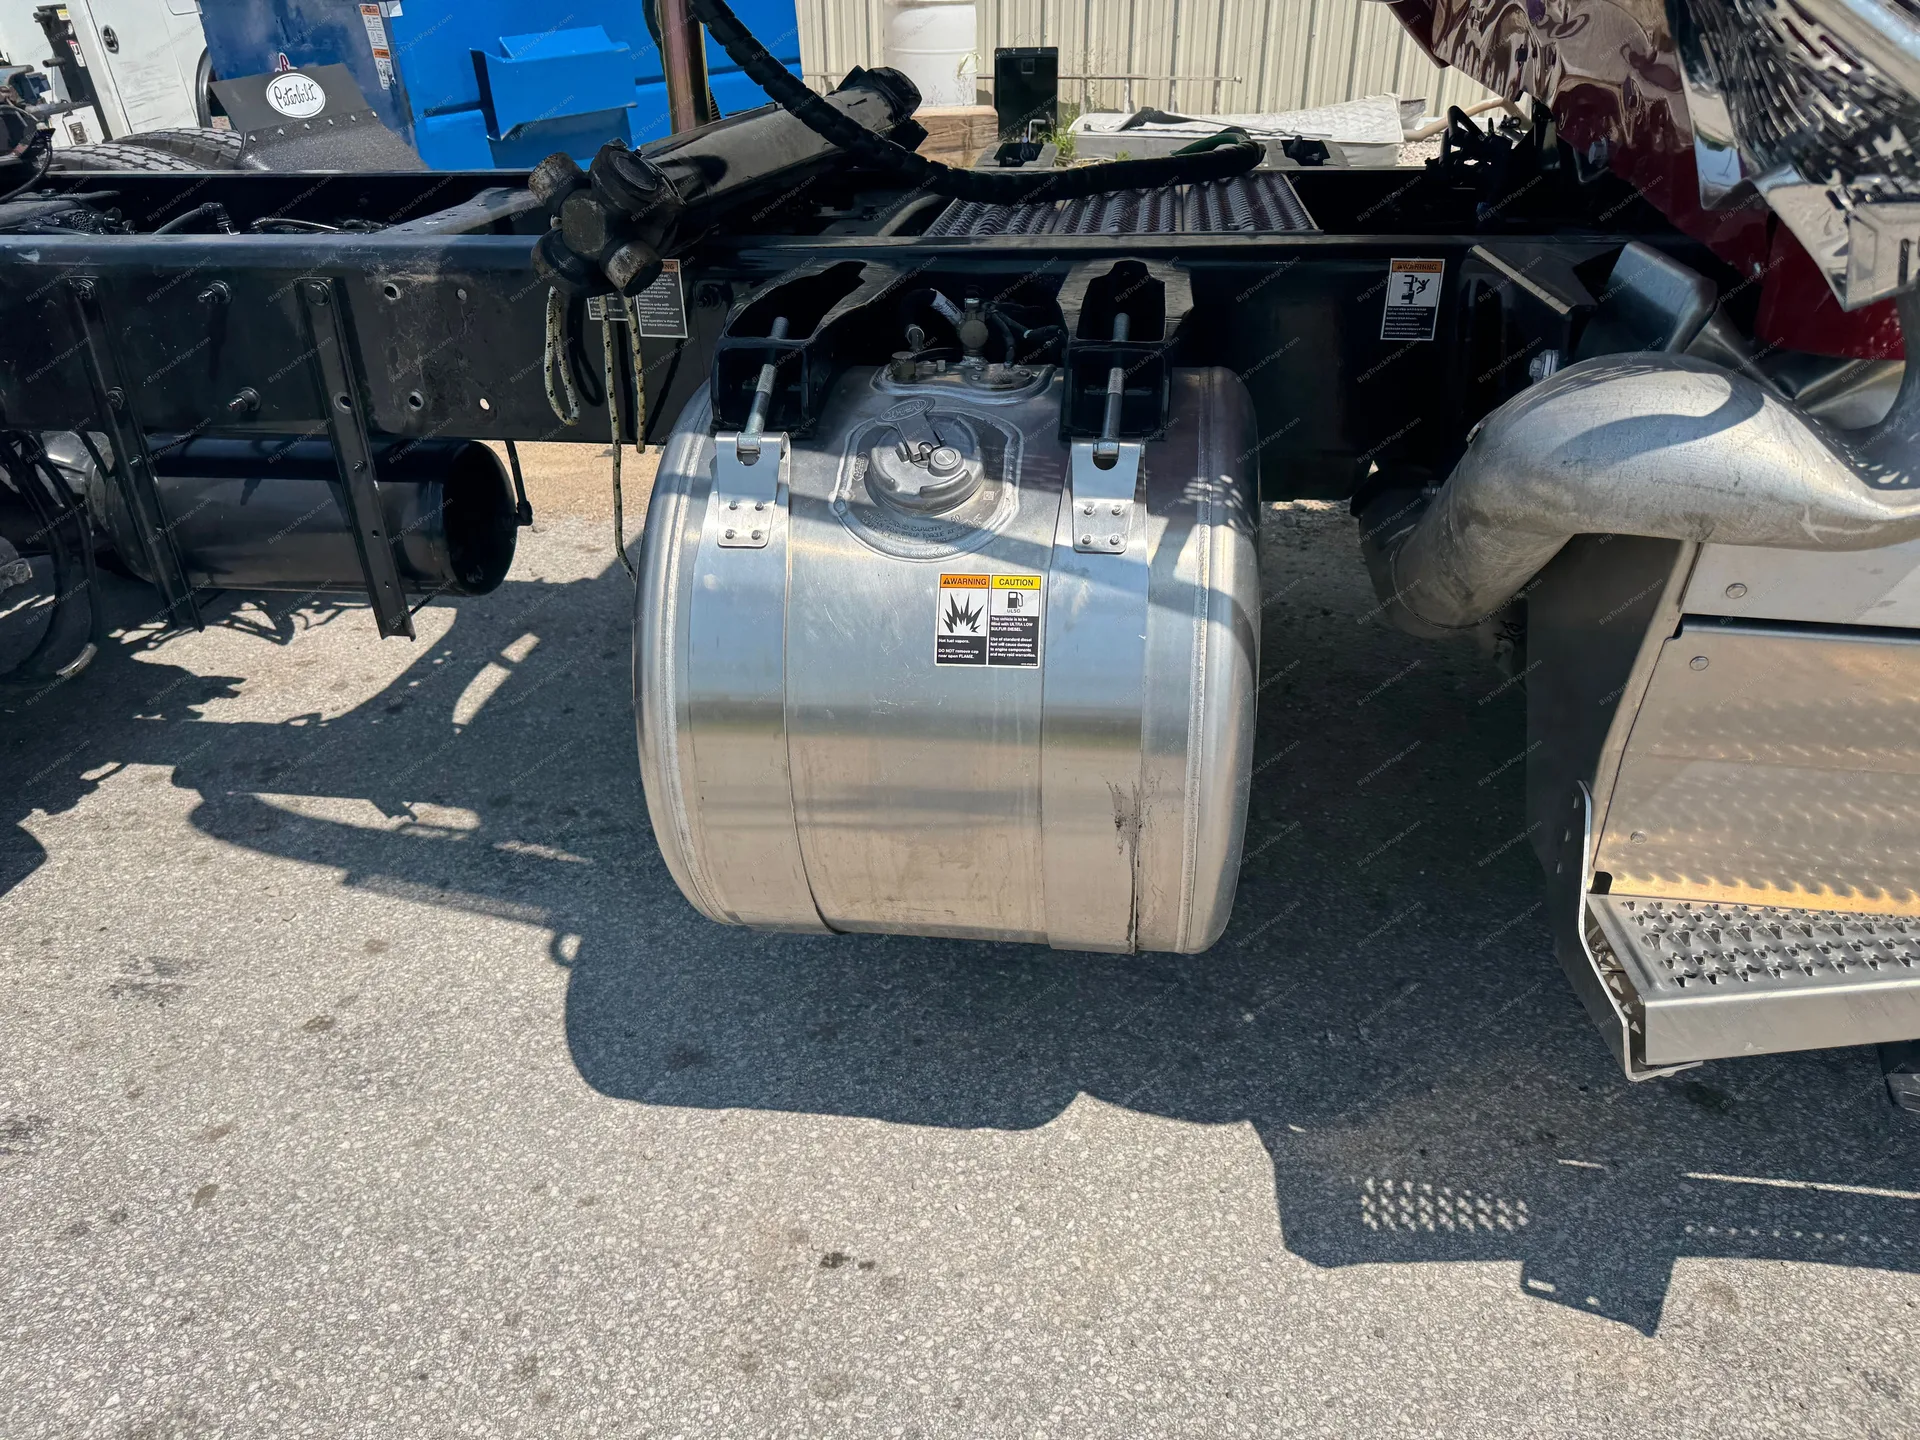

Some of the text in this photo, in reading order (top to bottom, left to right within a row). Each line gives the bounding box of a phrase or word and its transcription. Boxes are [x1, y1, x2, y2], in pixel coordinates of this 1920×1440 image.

[273, 83, 317, 110] Peterbilt
[950, 578, 987, 586] WARNING
[999, 578, 1034, 586] CAUTION
